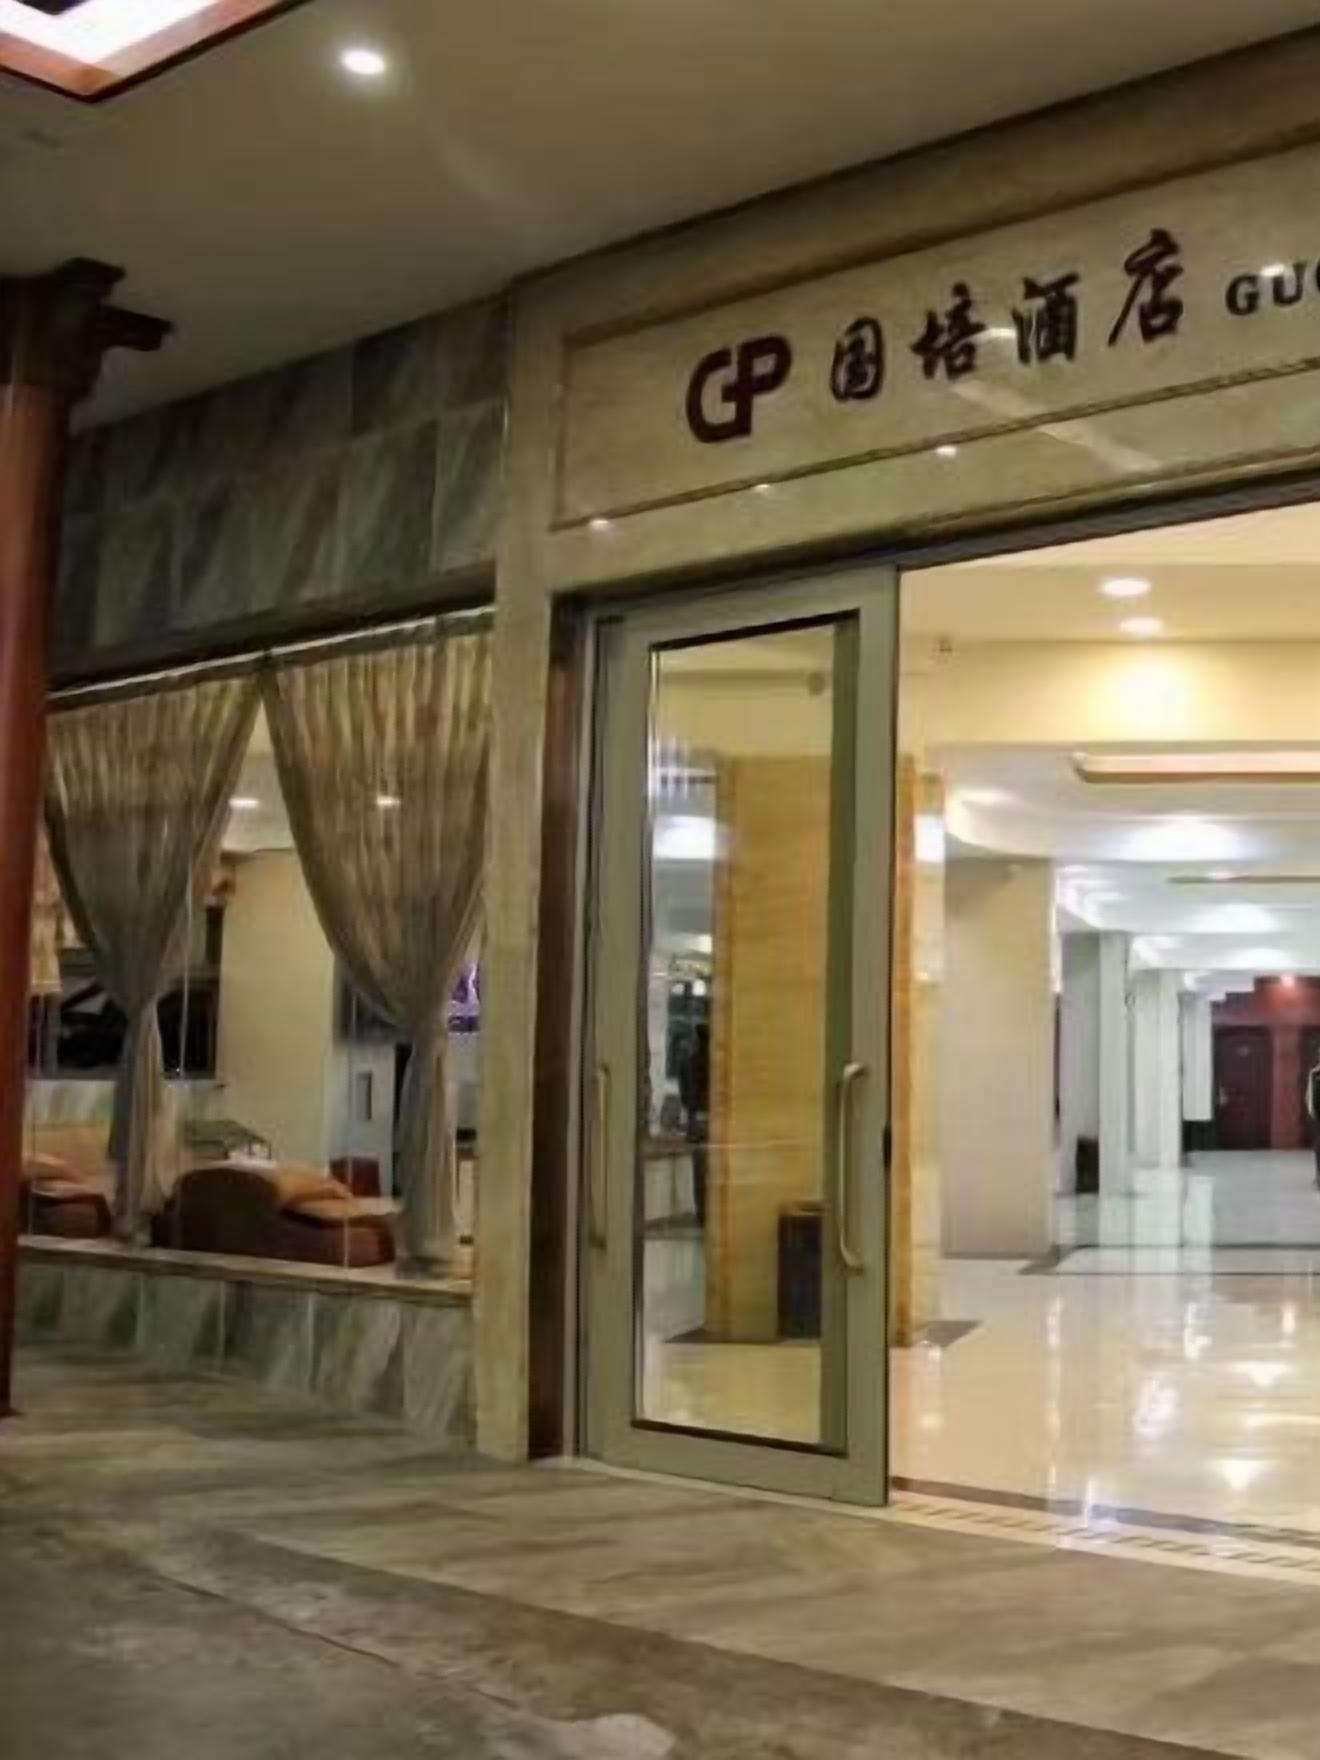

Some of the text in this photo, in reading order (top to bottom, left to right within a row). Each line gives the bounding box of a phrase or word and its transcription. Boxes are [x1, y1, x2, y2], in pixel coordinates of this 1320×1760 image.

[829, 228, 1186, 402] 国培酒店
[685, 335, 792, 444] GP
